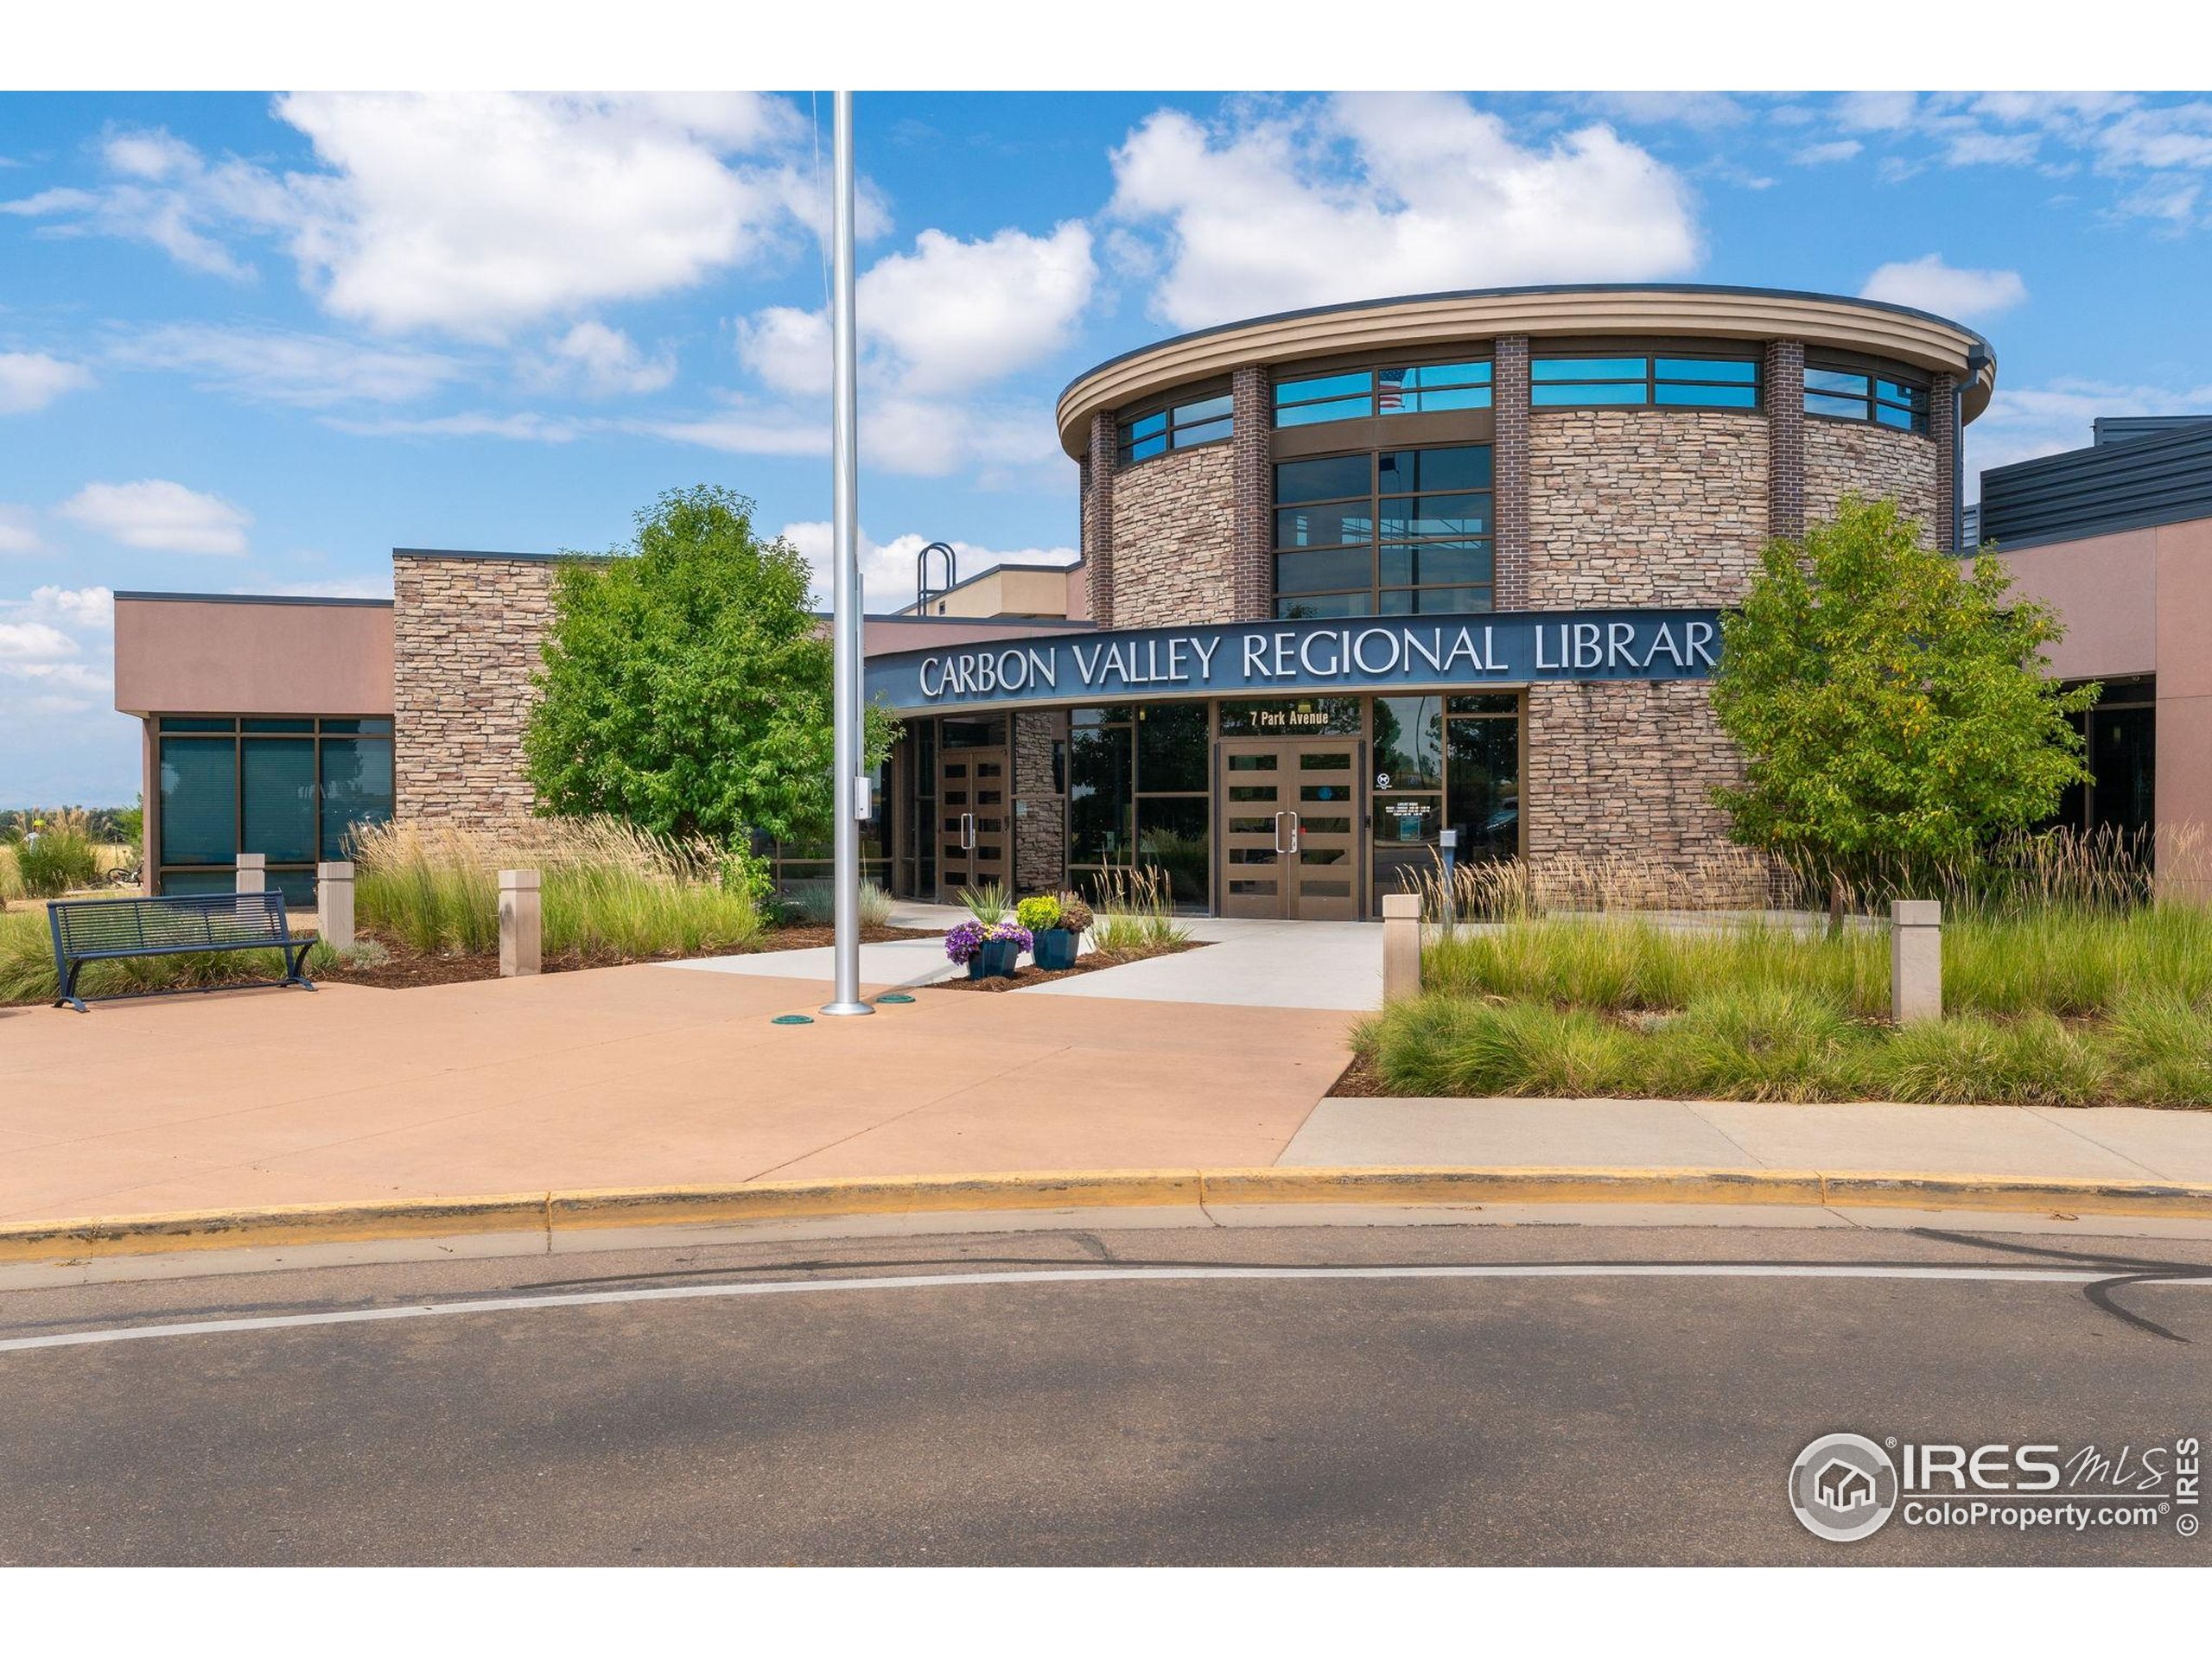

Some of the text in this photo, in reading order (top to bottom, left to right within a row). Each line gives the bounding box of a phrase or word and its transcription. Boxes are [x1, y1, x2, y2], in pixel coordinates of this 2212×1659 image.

[918, 620, 1728, 697] CARBON VALLEY REGIONAL LIBRAR
[1249, 711, 1329, 726] 7 Park Avenue
